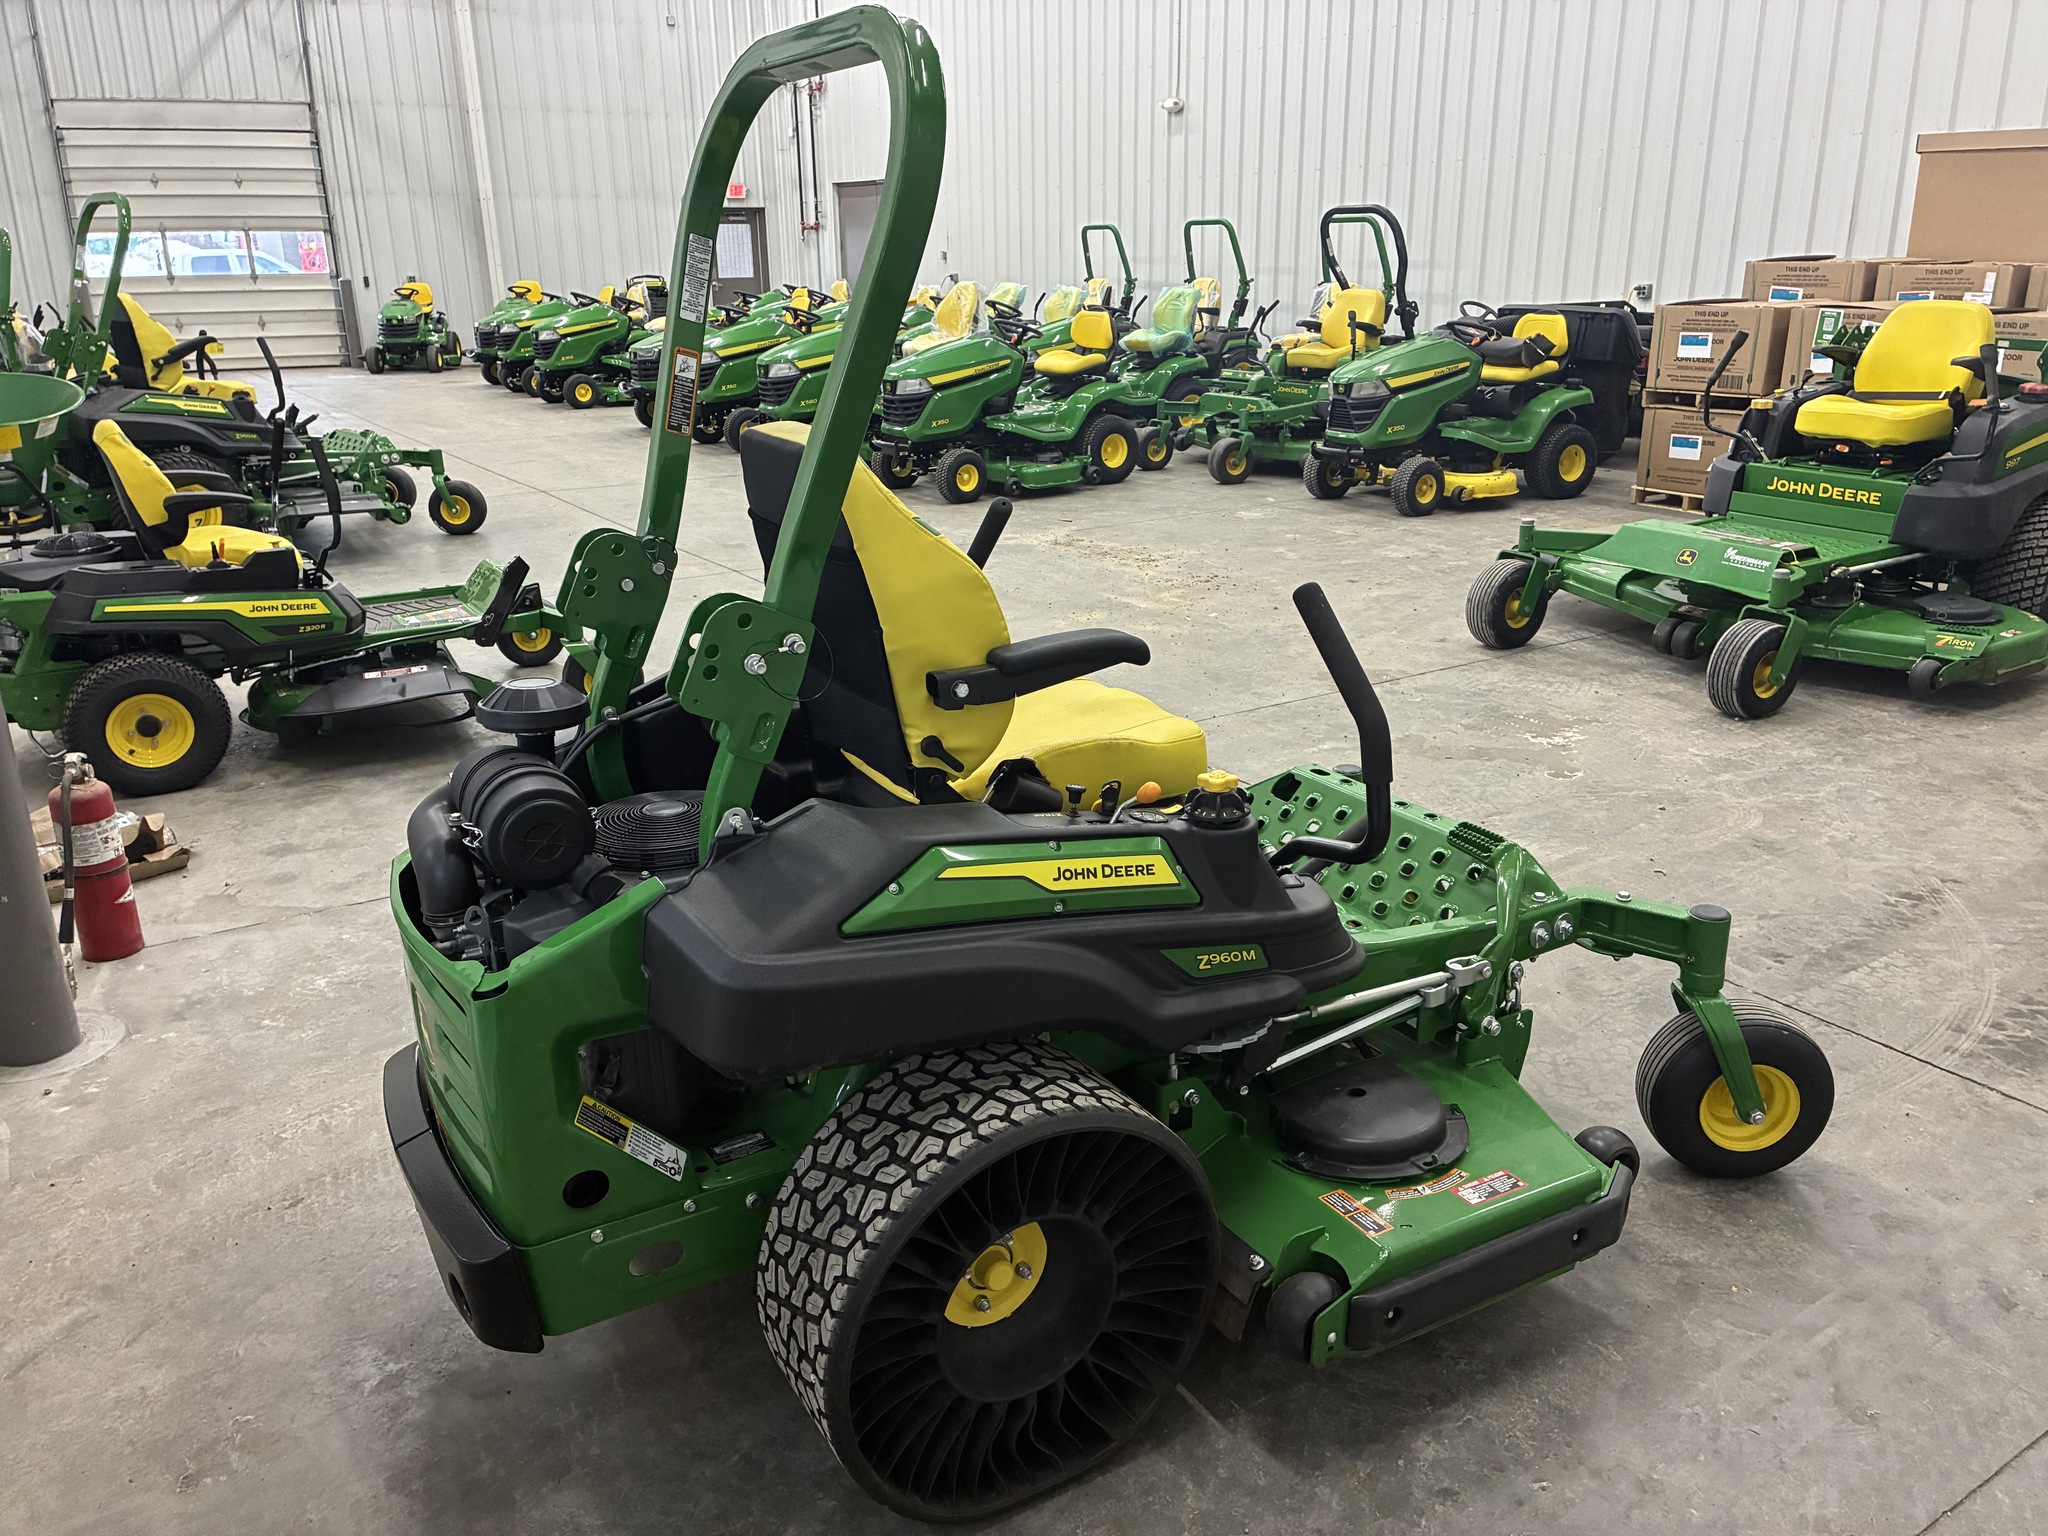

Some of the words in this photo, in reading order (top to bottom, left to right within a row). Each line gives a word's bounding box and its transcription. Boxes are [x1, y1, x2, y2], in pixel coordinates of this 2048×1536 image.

[1276, 385, 1291, 393] JOHN
[1291, 386, 1309, 395] DEERE
[1386, 424, 1406, 434] X350
[2005, 456, 2022, 470] 997
[1766, 476, 1815, 496] JOHN
[1818, 482, 1882, 506] DEERE
[249, 604, 280, 613] JOHN
[280, 602, 318, 612] DEERE
[1052, 866, 1098, 882] JOHN
[1101, 863, 1156, 879] DEERE
[1196, 949, 1256, 971] Z960M
[597, 1104, 621, 1122] CAUTION
